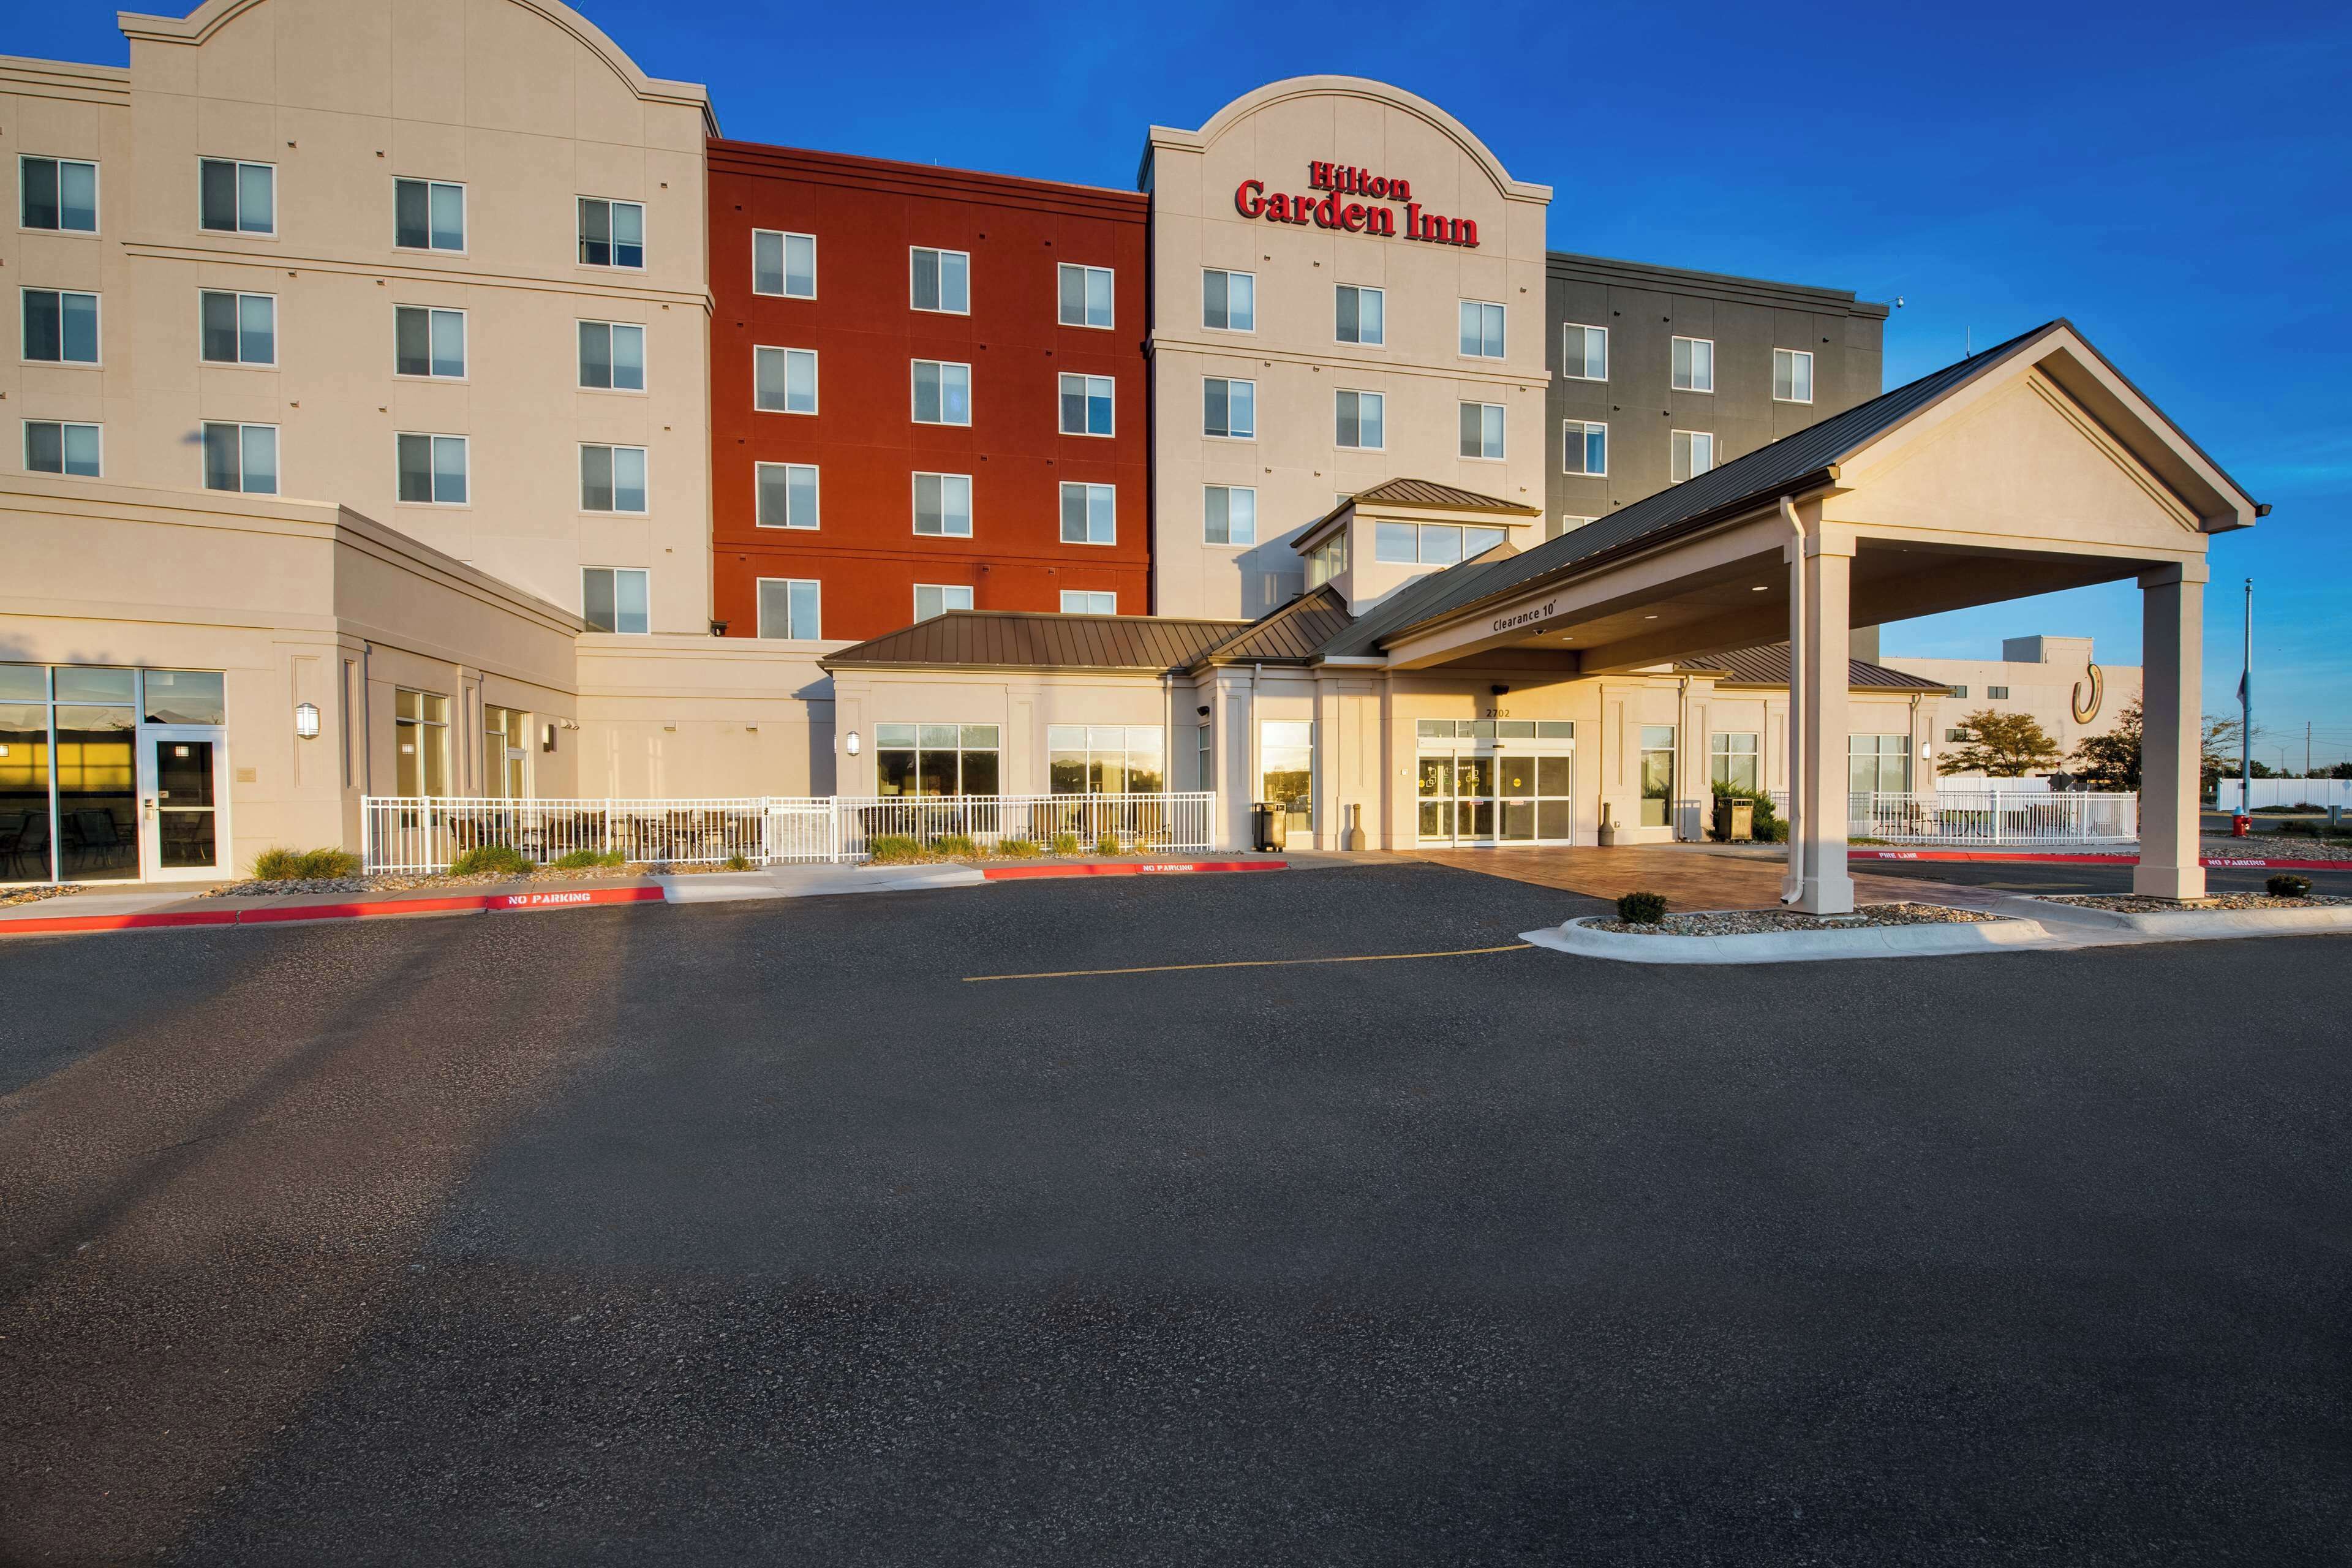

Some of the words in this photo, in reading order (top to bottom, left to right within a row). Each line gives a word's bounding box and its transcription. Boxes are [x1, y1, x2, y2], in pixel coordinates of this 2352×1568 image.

[1308, 160, 1412, 202] Hilton
[1235, 179, 1396, 237] Garden
[1404, 202, 1480, 247] Inn
[1493, 609, 1539, 631] Clearance
[1486, 709, 1510, 717] 2702
[508, 895, 527, 905] NO
[532, 892, 591, 903] PARKING
